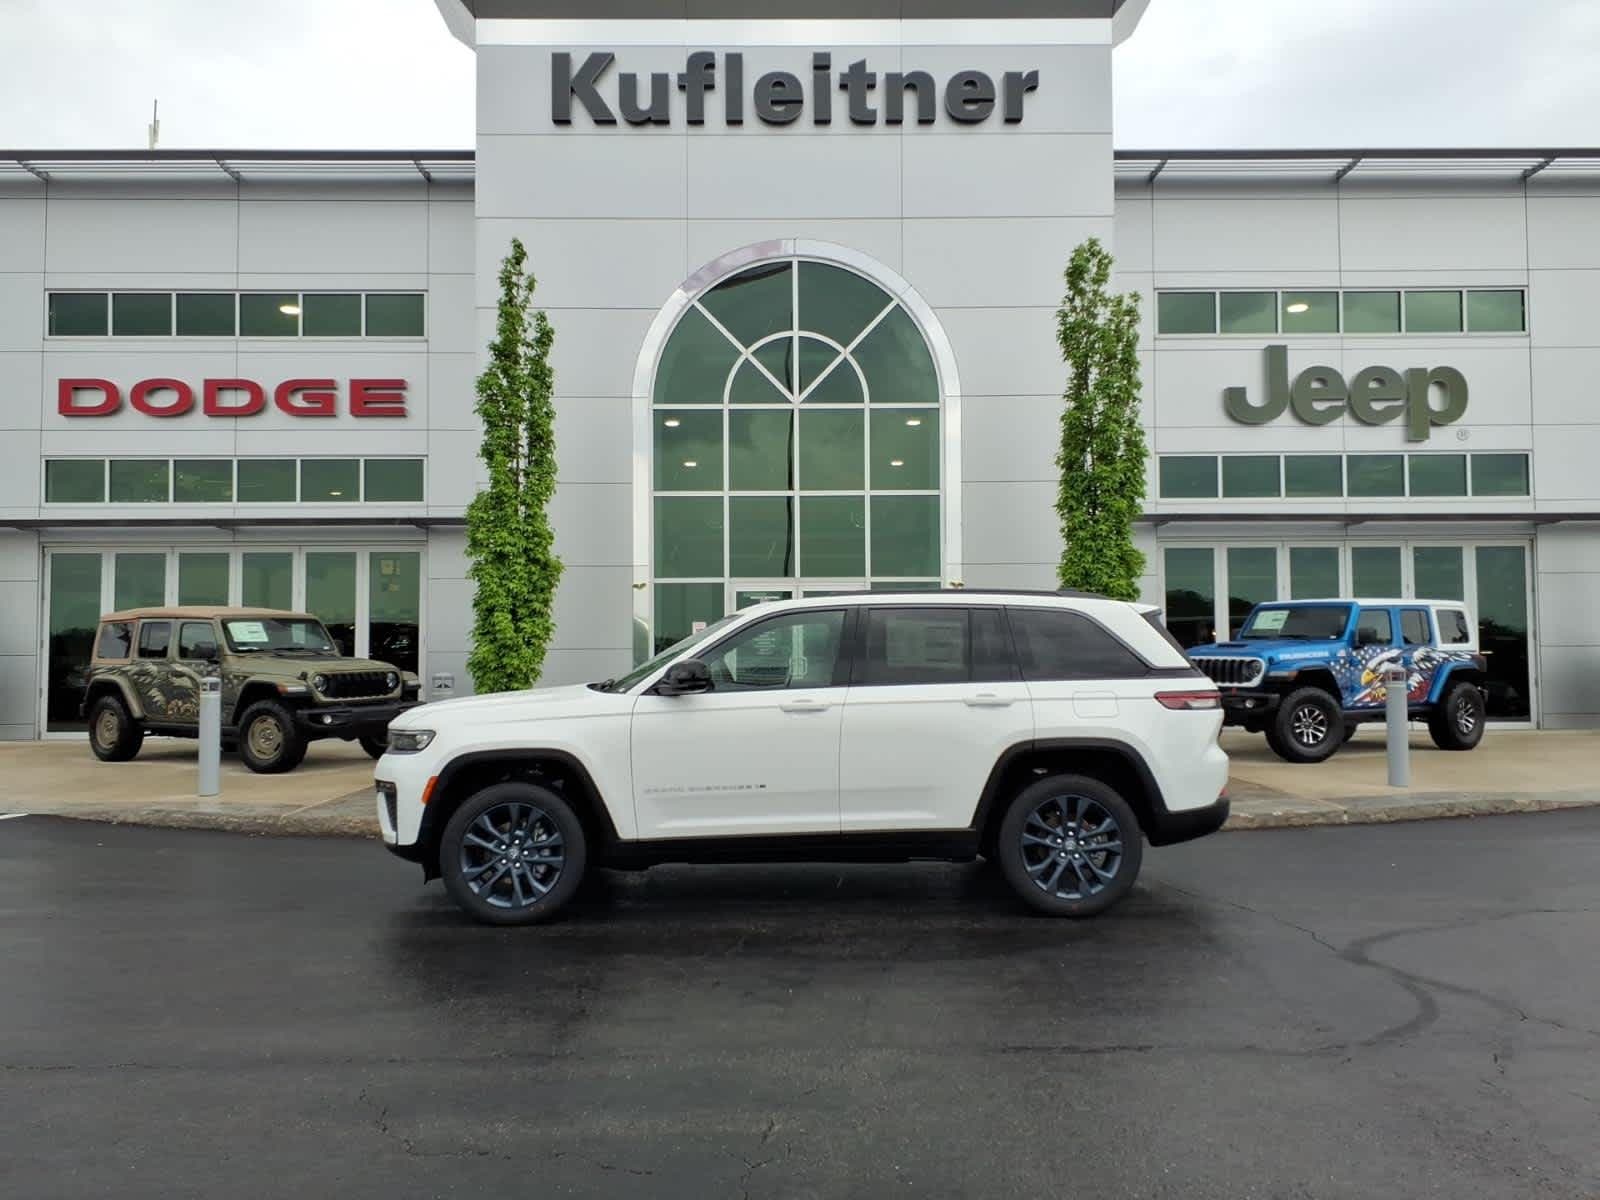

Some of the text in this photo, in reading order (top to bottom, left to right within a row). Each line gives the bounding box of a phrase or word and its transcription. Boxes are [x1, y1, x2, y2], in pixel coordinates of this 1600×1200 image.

[551, 51, 1039, 126] Kufleitner
[58, 378, 407, 418] DODGE
[1223, 344, 1469, 443] Jeep
